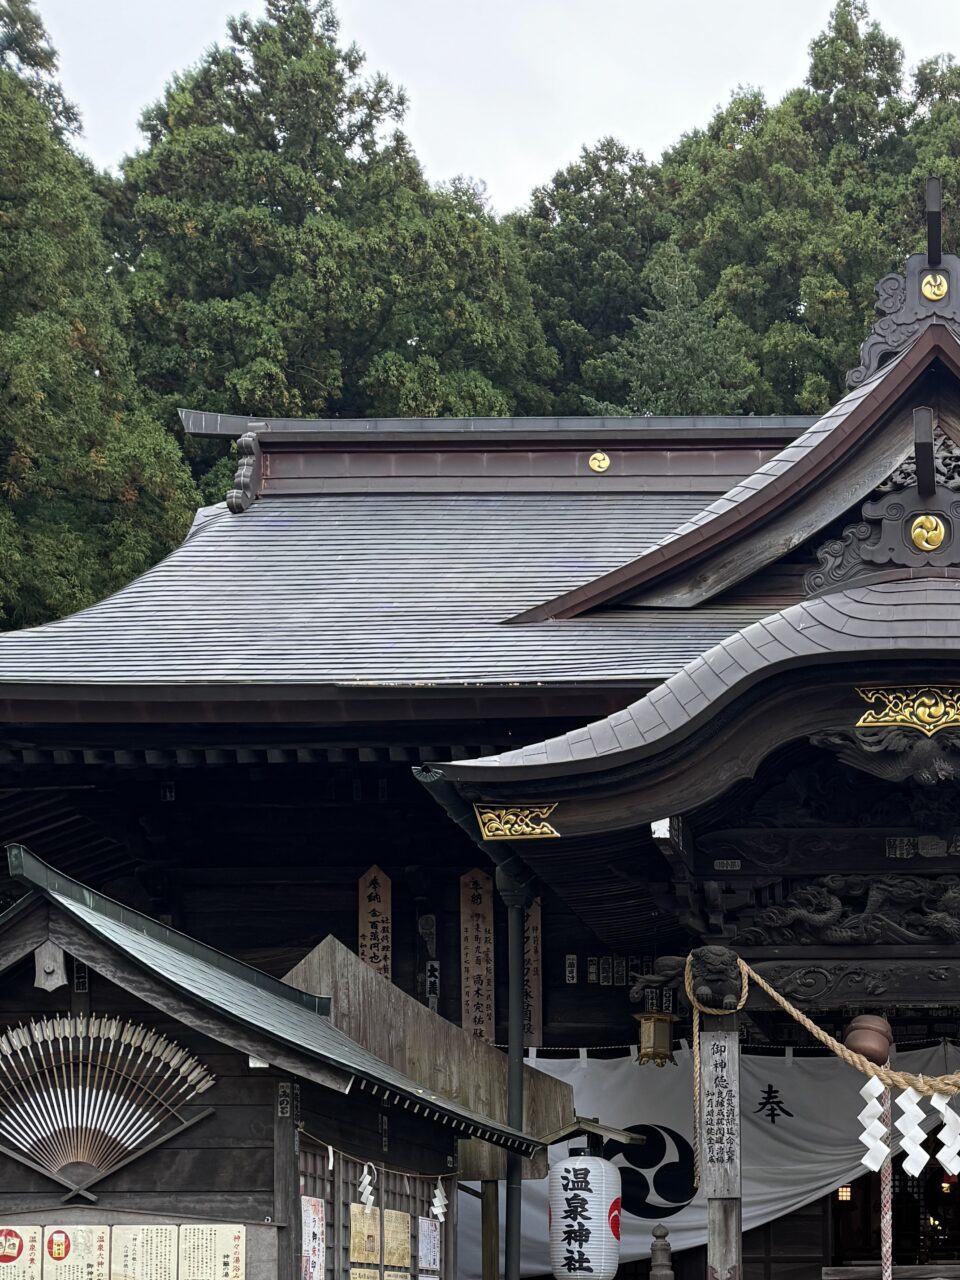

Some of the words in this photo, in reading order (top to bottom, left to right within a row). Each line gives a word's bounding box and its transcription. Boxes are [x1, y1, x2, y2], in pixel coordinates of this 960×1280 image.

[368, 876, 382, 904] 奉納
[368, 908, 382, 963] 金百萬円也
[711, 1042, 730, 1089] 御神徳
[753, 1084, 793, 1124] 奉
[560, 1167, 593, 1273] 温泉神社
